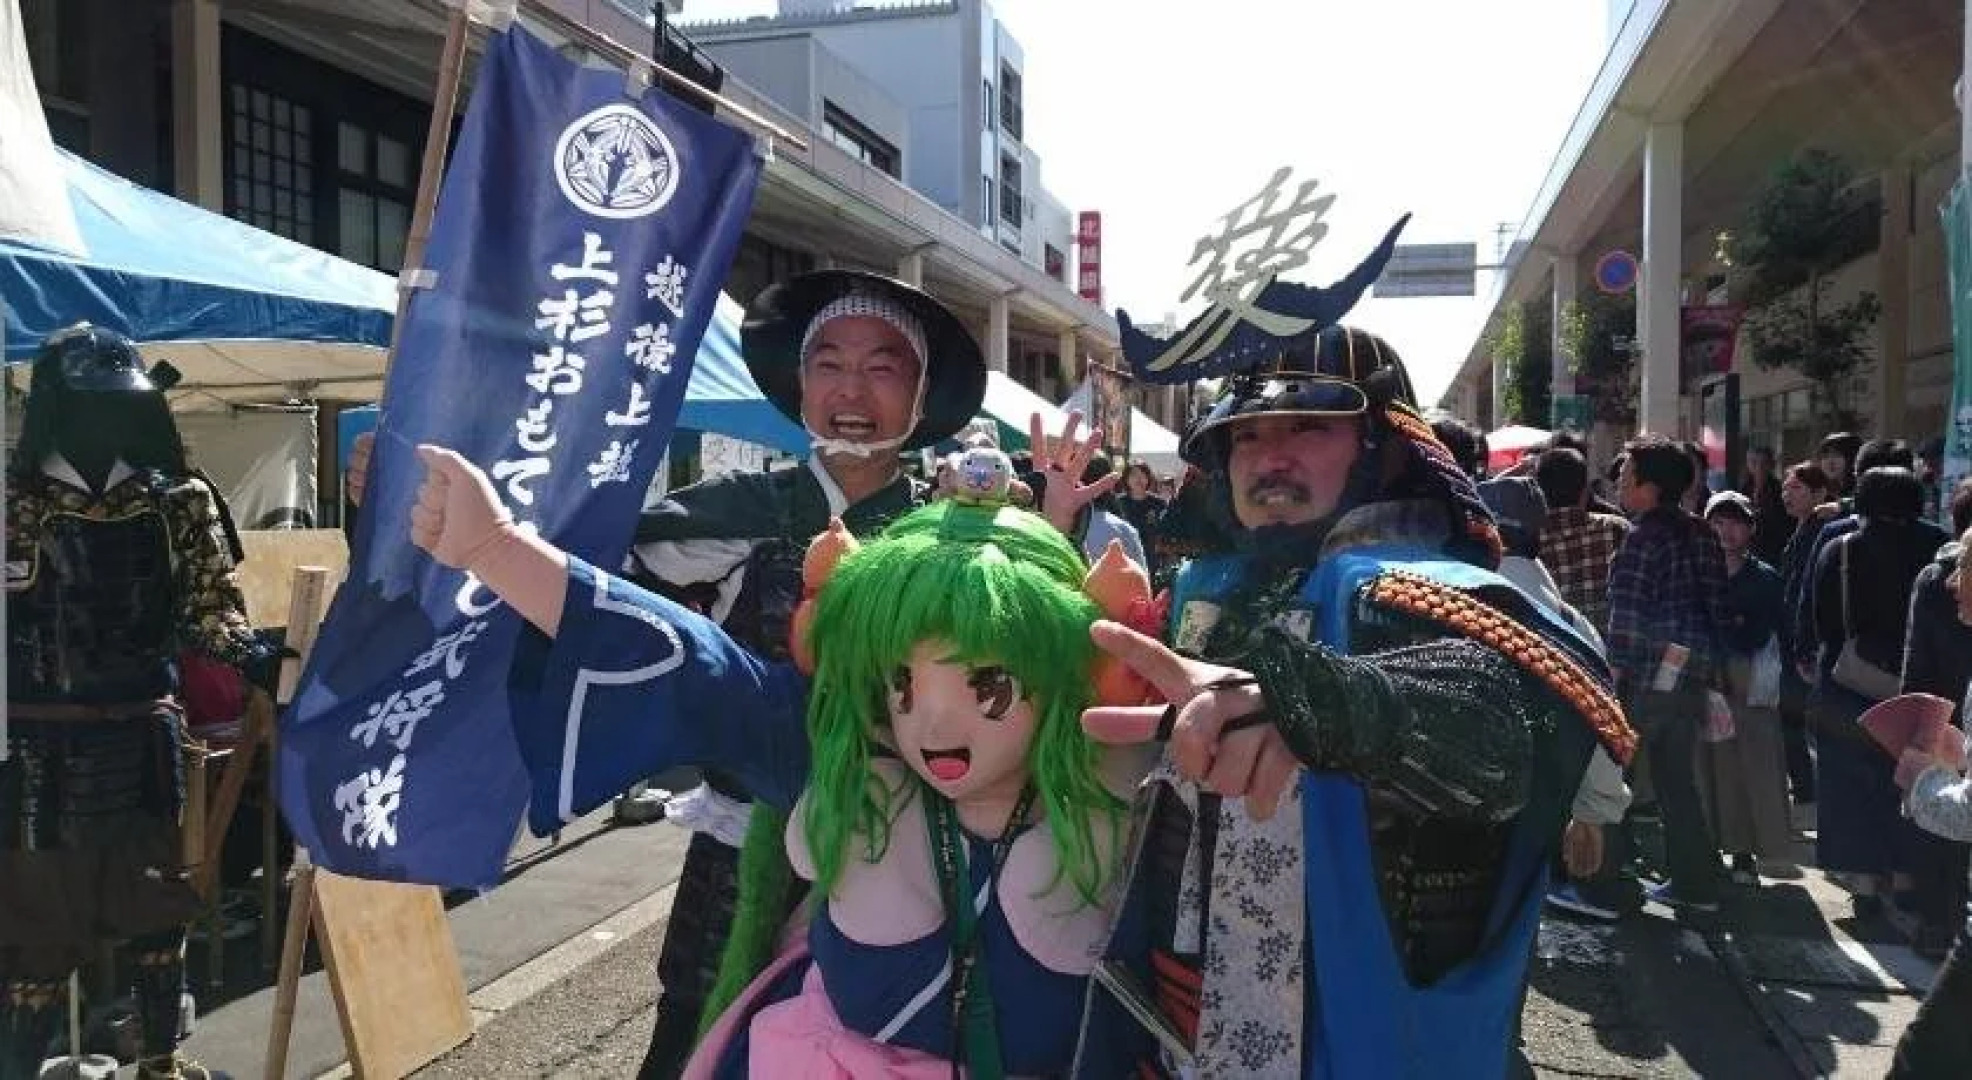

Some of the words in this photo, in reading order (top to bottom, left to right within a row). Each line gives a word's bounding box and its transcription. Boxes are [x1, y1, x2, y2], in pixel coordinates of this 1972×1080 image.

[333, 232, 619, 850] 上杉おもてし武将隊
[588, 255, 688, 488] 越後上越
